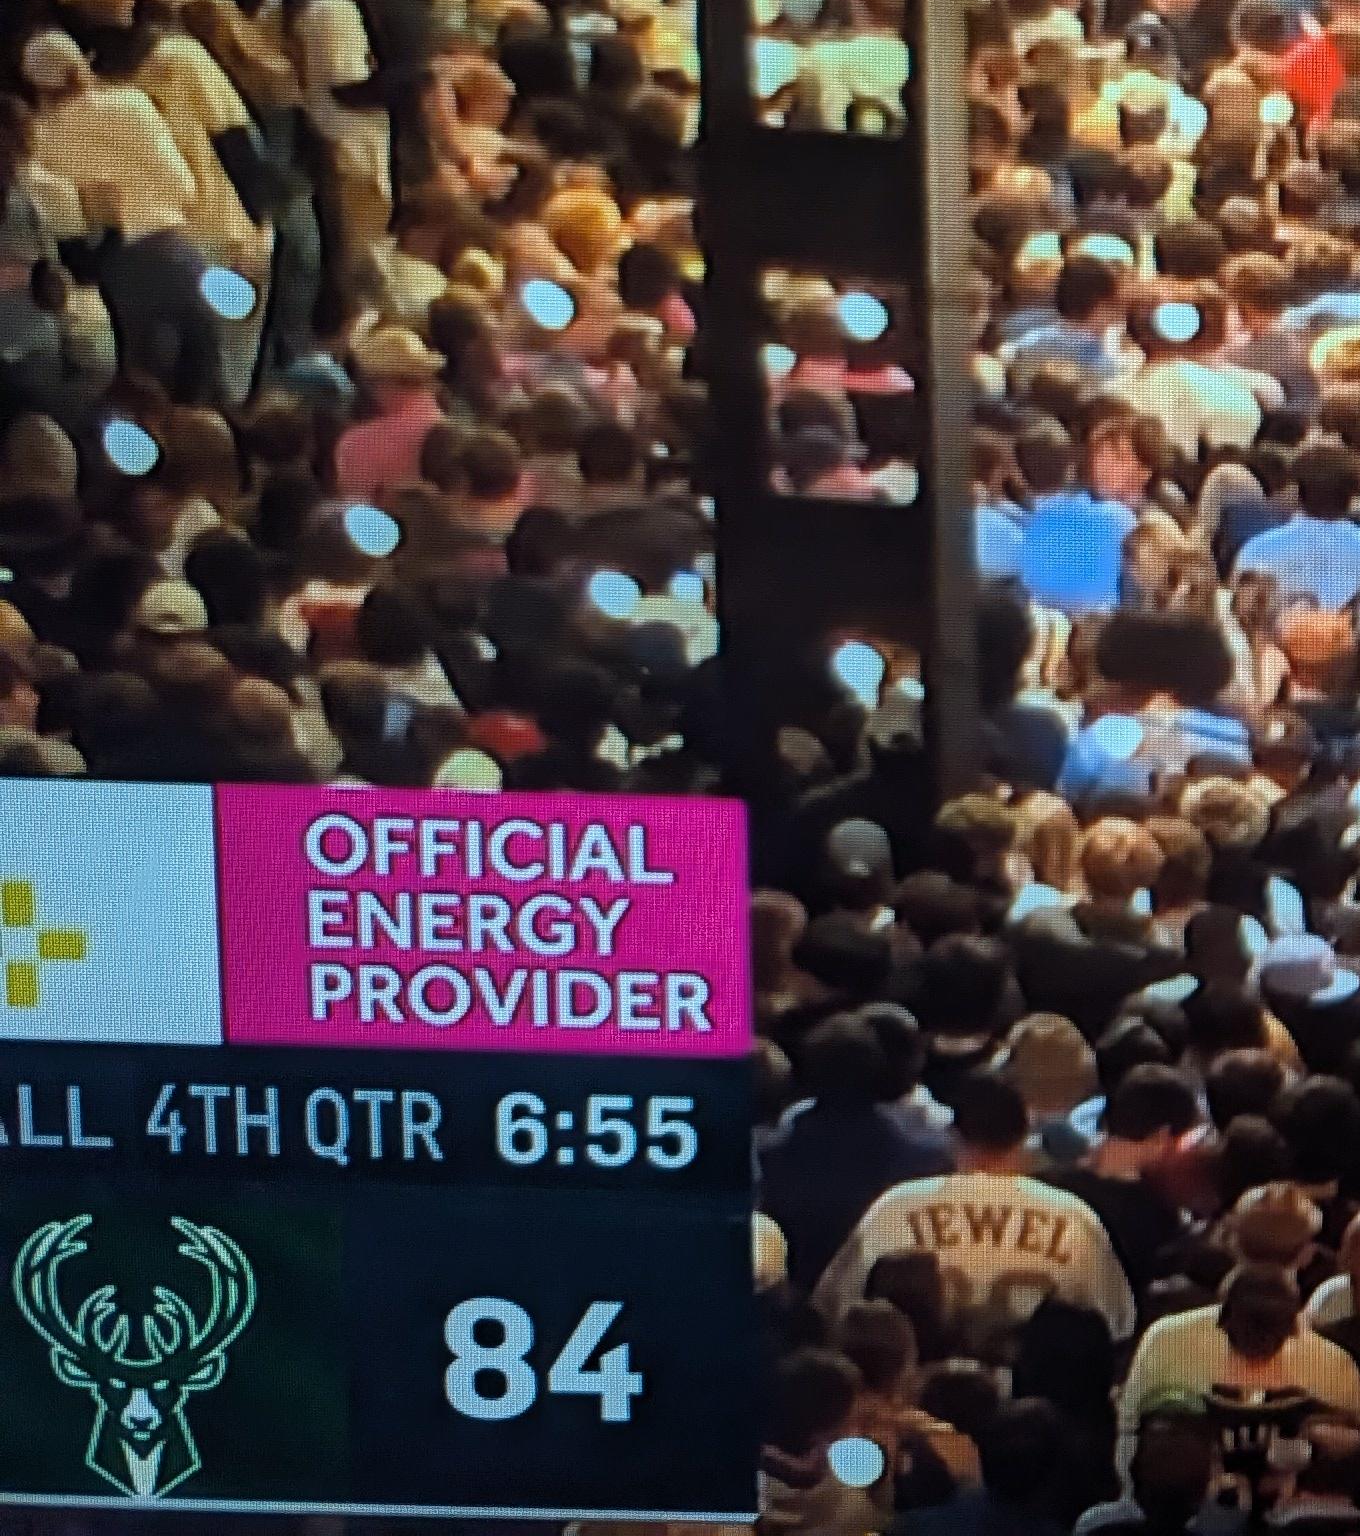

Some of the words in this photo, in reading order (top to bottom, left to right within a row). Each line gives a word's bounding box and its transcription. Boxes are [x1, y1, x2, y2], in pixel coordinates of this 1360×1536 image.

[304, 814, 675, 884] OFFICIAL
[305, 889, 630, 956] ENERGY
[309, 965, 713, 1033] PROVIDER
[0, 1083, 114, 1148] LL
[145, 1083, 281, 1156] 4TH
[304, 1086, 444, 1165] QTR
[496, 1091, 698, 1167] 6:55
[442, 1296, 644, 1422] 84
